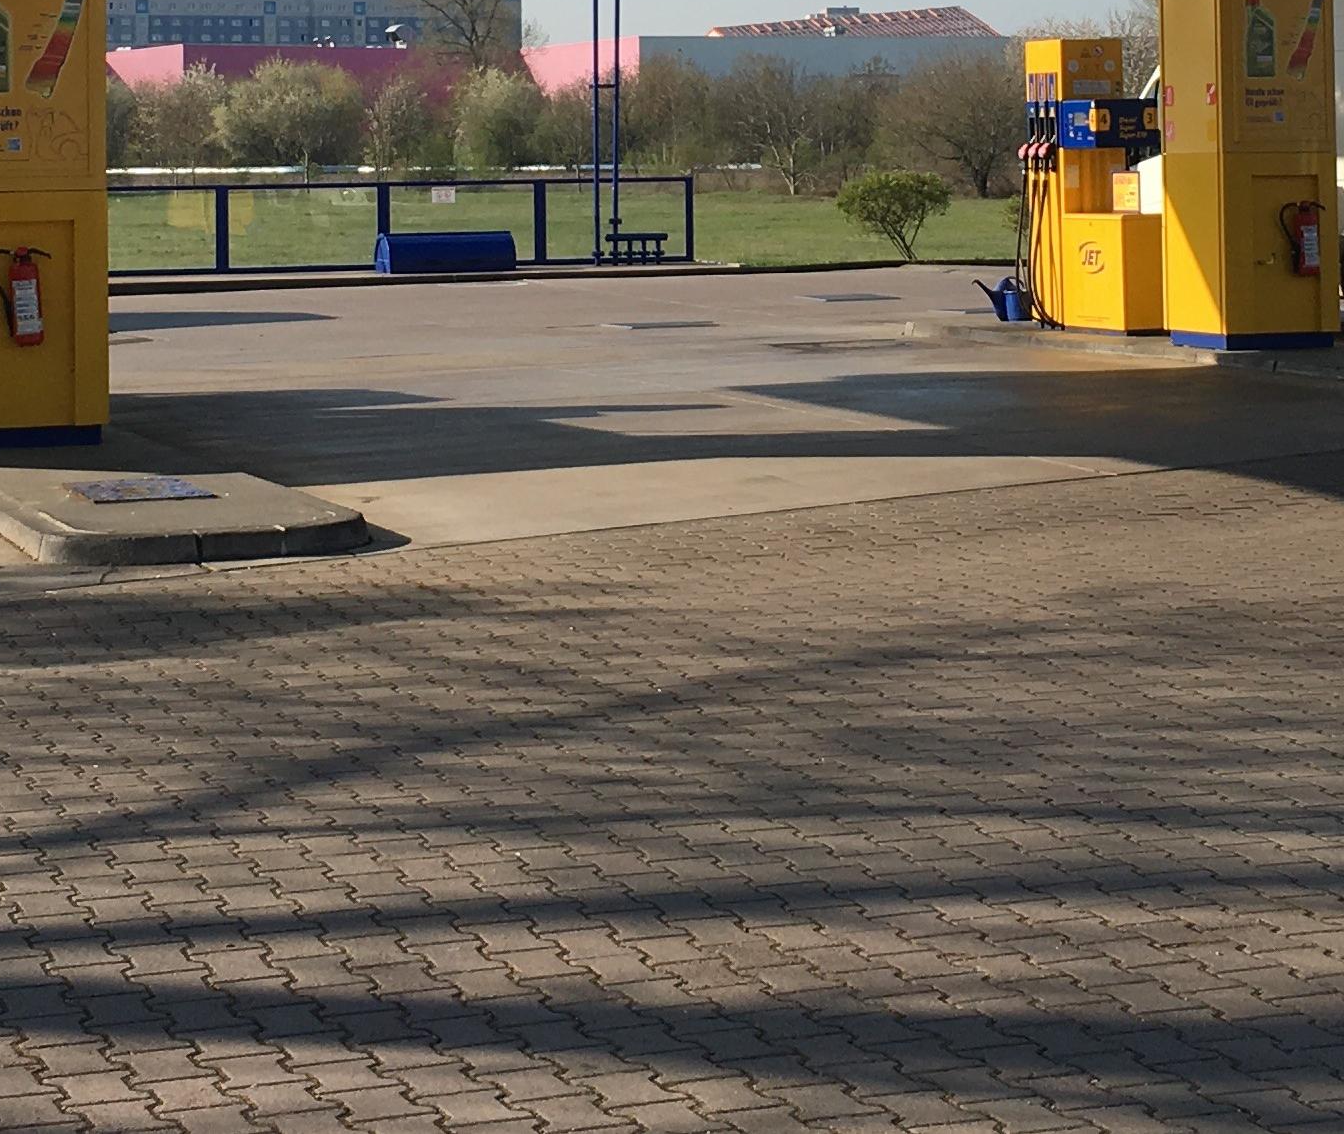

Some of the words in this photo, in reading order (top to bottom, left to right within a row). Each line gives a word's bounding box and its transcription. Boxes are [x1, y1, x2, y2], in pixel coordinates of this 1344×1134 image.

[1099, 113, 1108, 125] 4
[1146, 112, 1154, 124] 3
[1081, 249, 1102, 266] JET
